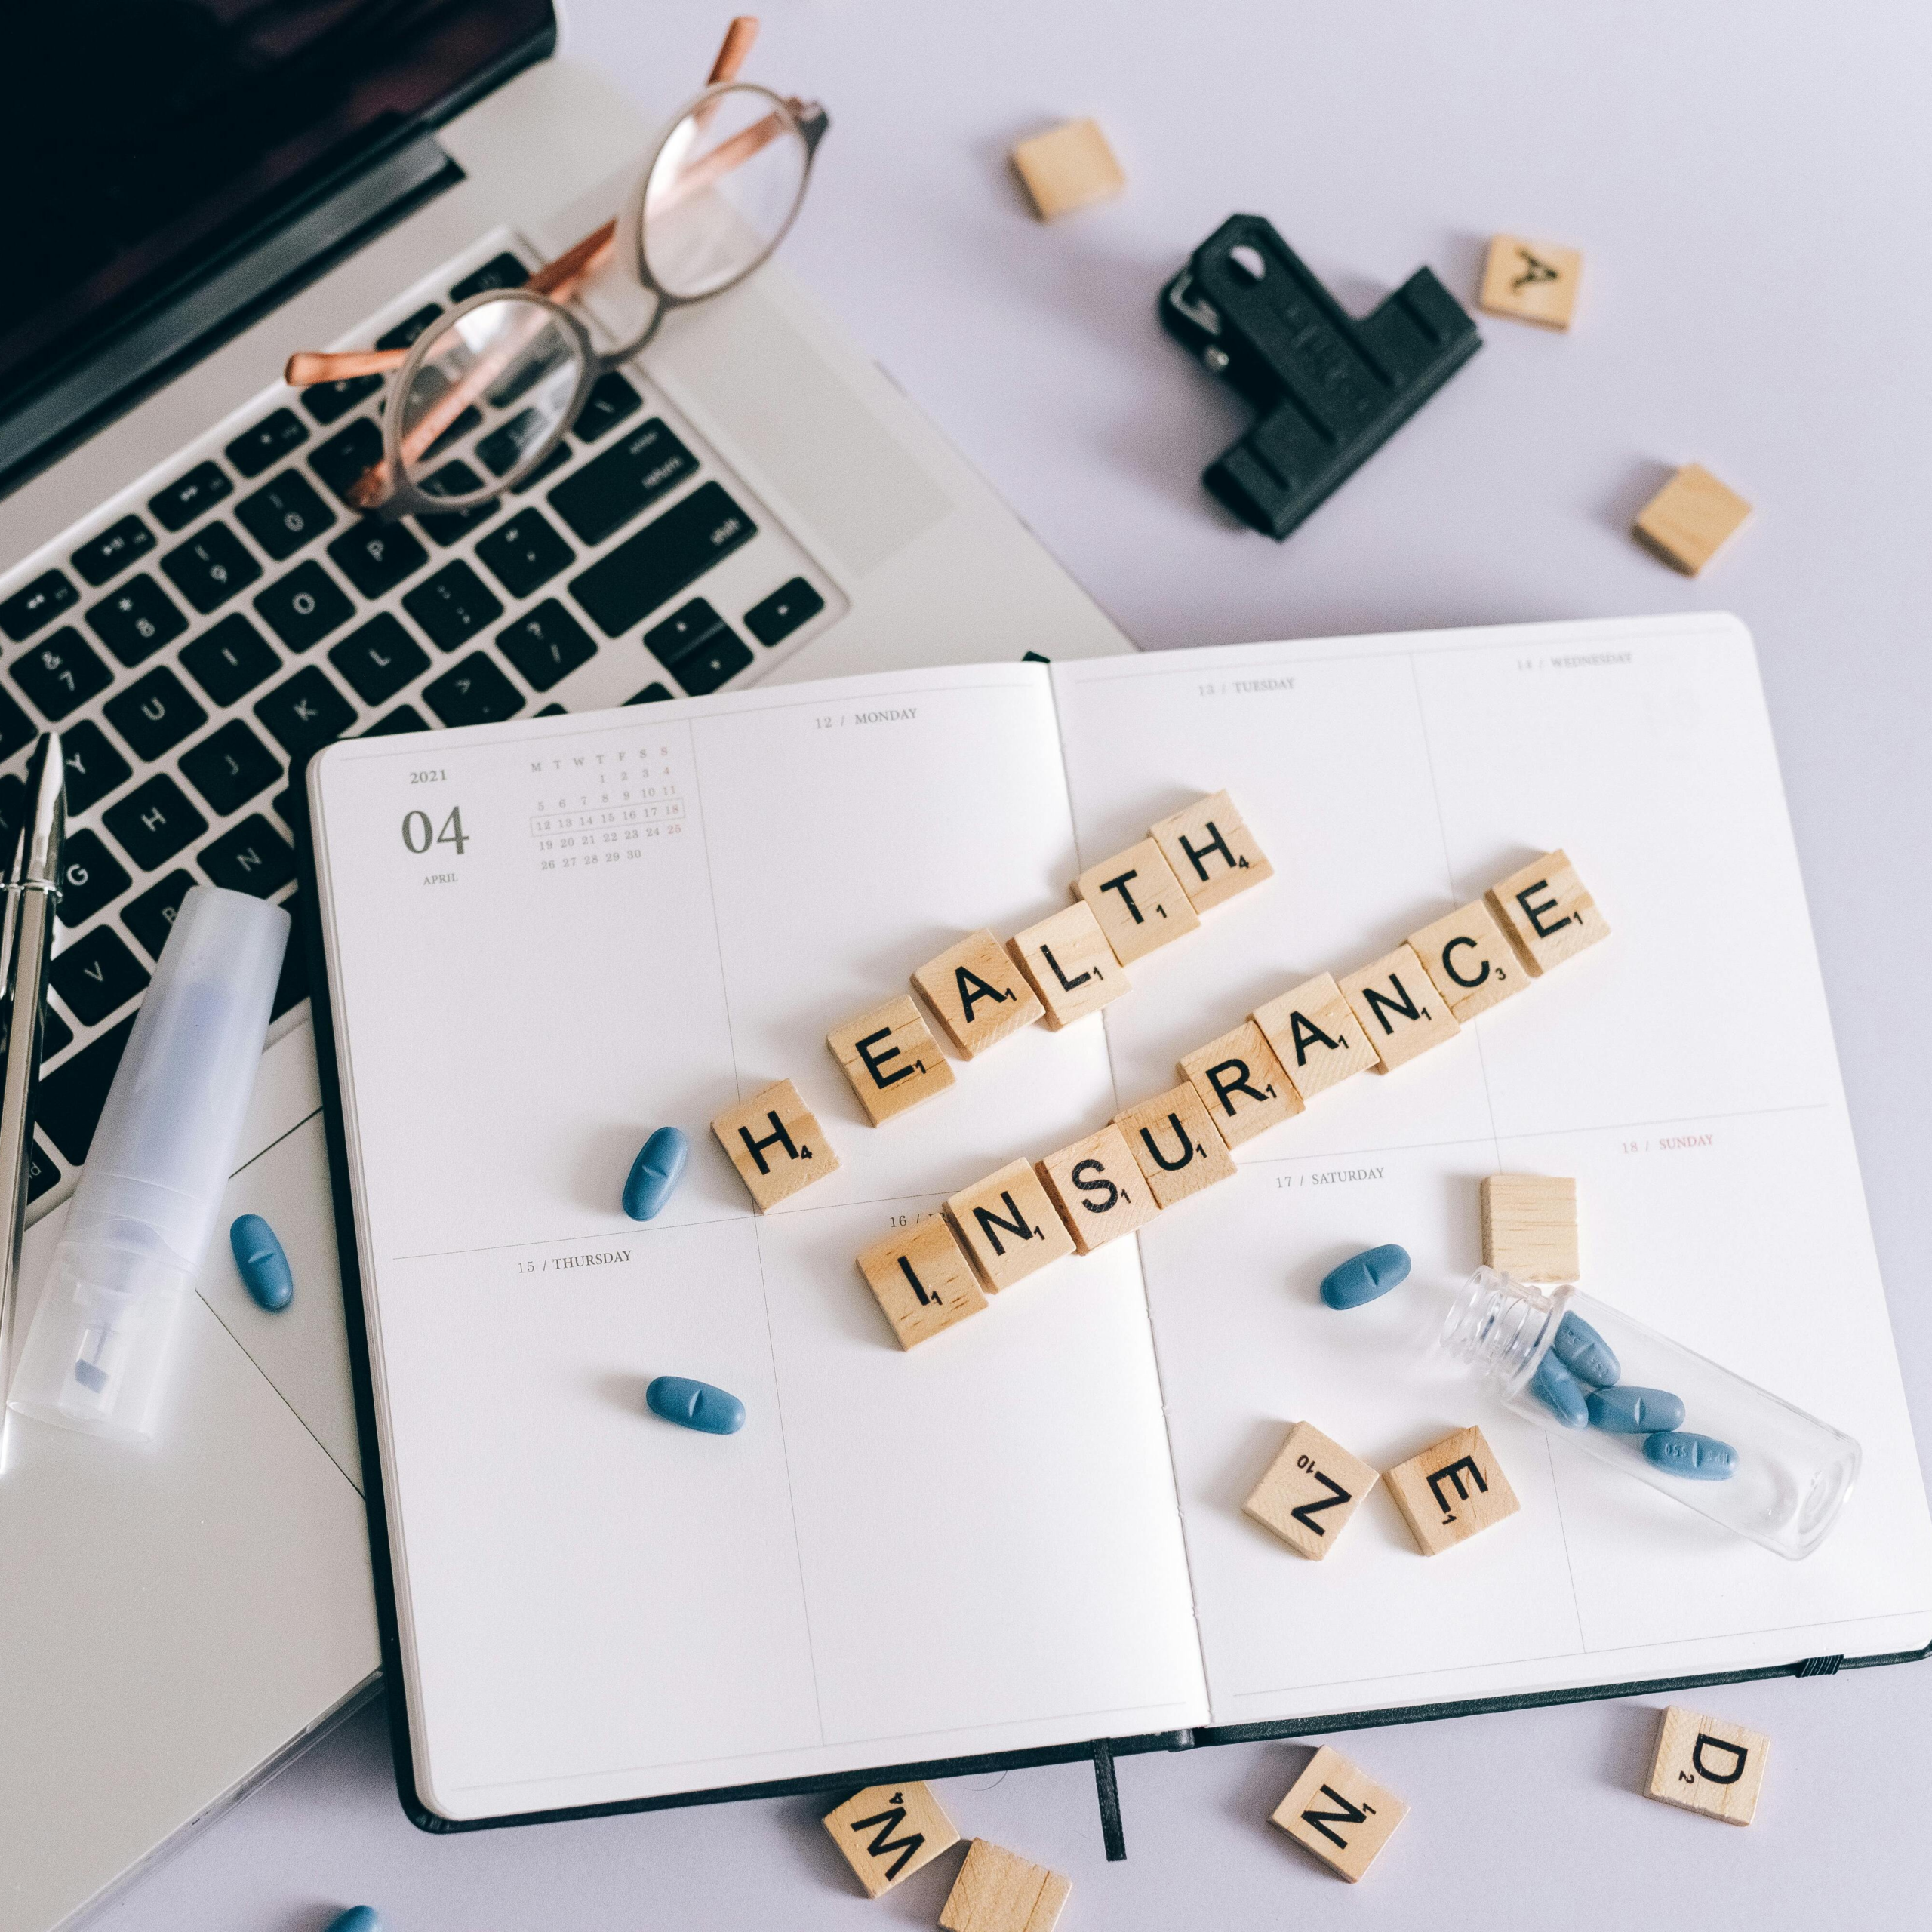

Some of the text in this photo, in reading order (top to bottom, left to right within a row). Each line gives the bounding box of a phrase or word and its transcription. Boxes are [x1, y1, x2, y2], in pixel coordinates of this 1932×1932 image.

[367, 539, 385, 561] P
[293, 592, 315, 614] O
[135, 618, 155, 638] 8
[369, 649, 391, 667] L
[60, 670, 76, 691] 7
[1233, 677, 1295, 693] TUESDAY
[140, 700, 166, 721] U
[294, 699, 318, 721] K
[816, 717, 832, 728] 12
[854, 708, 918, 724] MONDAY
[66, 752, 86, 774] Y
[531, 746, 668, 772] M T W T F S S
[410, 769, 448, 783] 2021
[600, 766, 670, 783] 1 2 3 4
[537, 786, 675, 811] 5 6 7 8 9 10 11
[141, 808, 167, 832] H
[537, 804, 679, 831] 12 13 14 15 16 17 18
[401, 805, 469, 855] 04
[540, 824, 681, 851] 19 20 21 22 23 24 25
[236, 847, 263, 872] N
[541, 849, 641, 870] 26 27 28 29 30
[67, 863, 89, 887] G
[423, 873, 458, 885] APRIL
[84, 961, 104, 983] V
[1623, 1141, 1638, 1153] 18
[1659, 1134, 1714, 1150] SUNDAY
[1276, 1176, 1292, 1188] 17
[1312, 1167, 1385, 1185] SATURDAY
[890, 1214, 907, 1228] 16
[518, 1260, 535, 1273] 15
[552, 1250, 632, 1269] THURSDAY
[1291, 1454, 1352, 1537] Z 10
[1426, 1454, 1488, 1515] E
[1678, 1733, 1749, 1786] D 2
